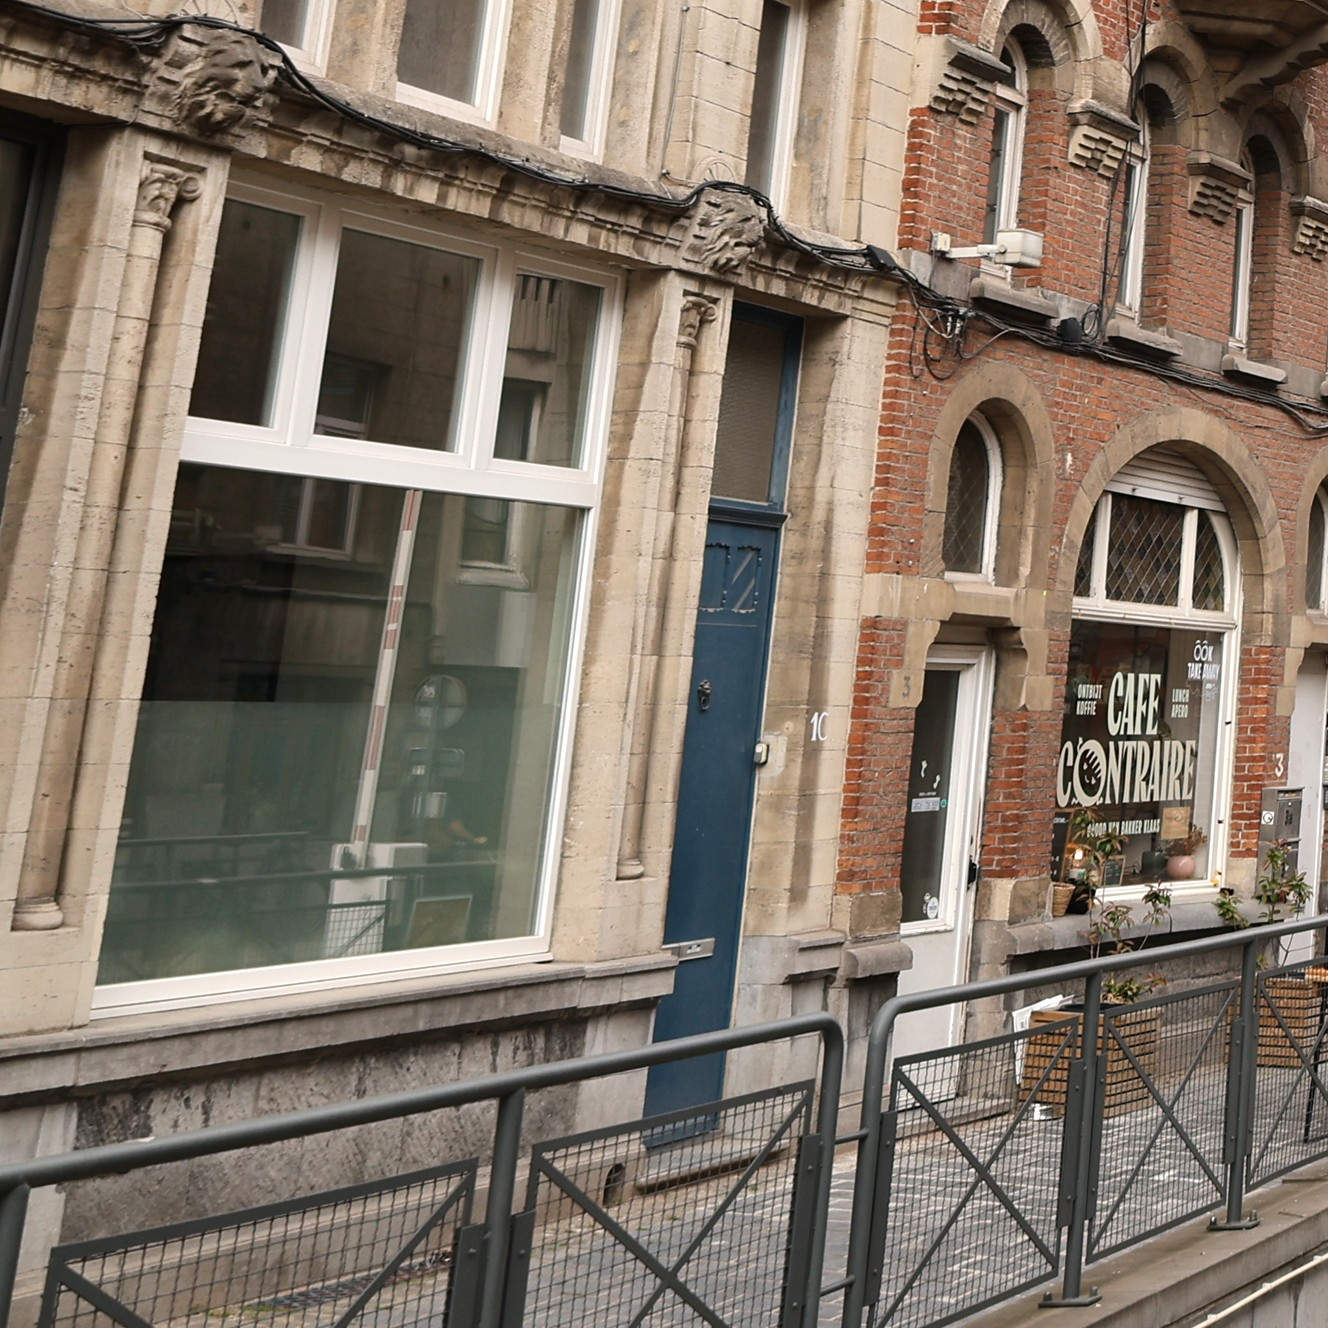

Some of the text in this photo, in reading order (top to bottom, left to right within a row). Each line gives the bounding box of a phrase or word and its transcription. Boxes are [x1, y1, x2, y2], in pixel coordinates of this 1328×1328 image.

[1076, 700, 1097, 716] KOFFIE
[1108, 671, 1161, 736] CAFE
[810, 711, 829, 742] 1C
[1056, 737, 1197, 809] CONTRAIRE
[1274, 752, 1285, 778] 3
[1143, 818, 1161, 834] KLAAS
